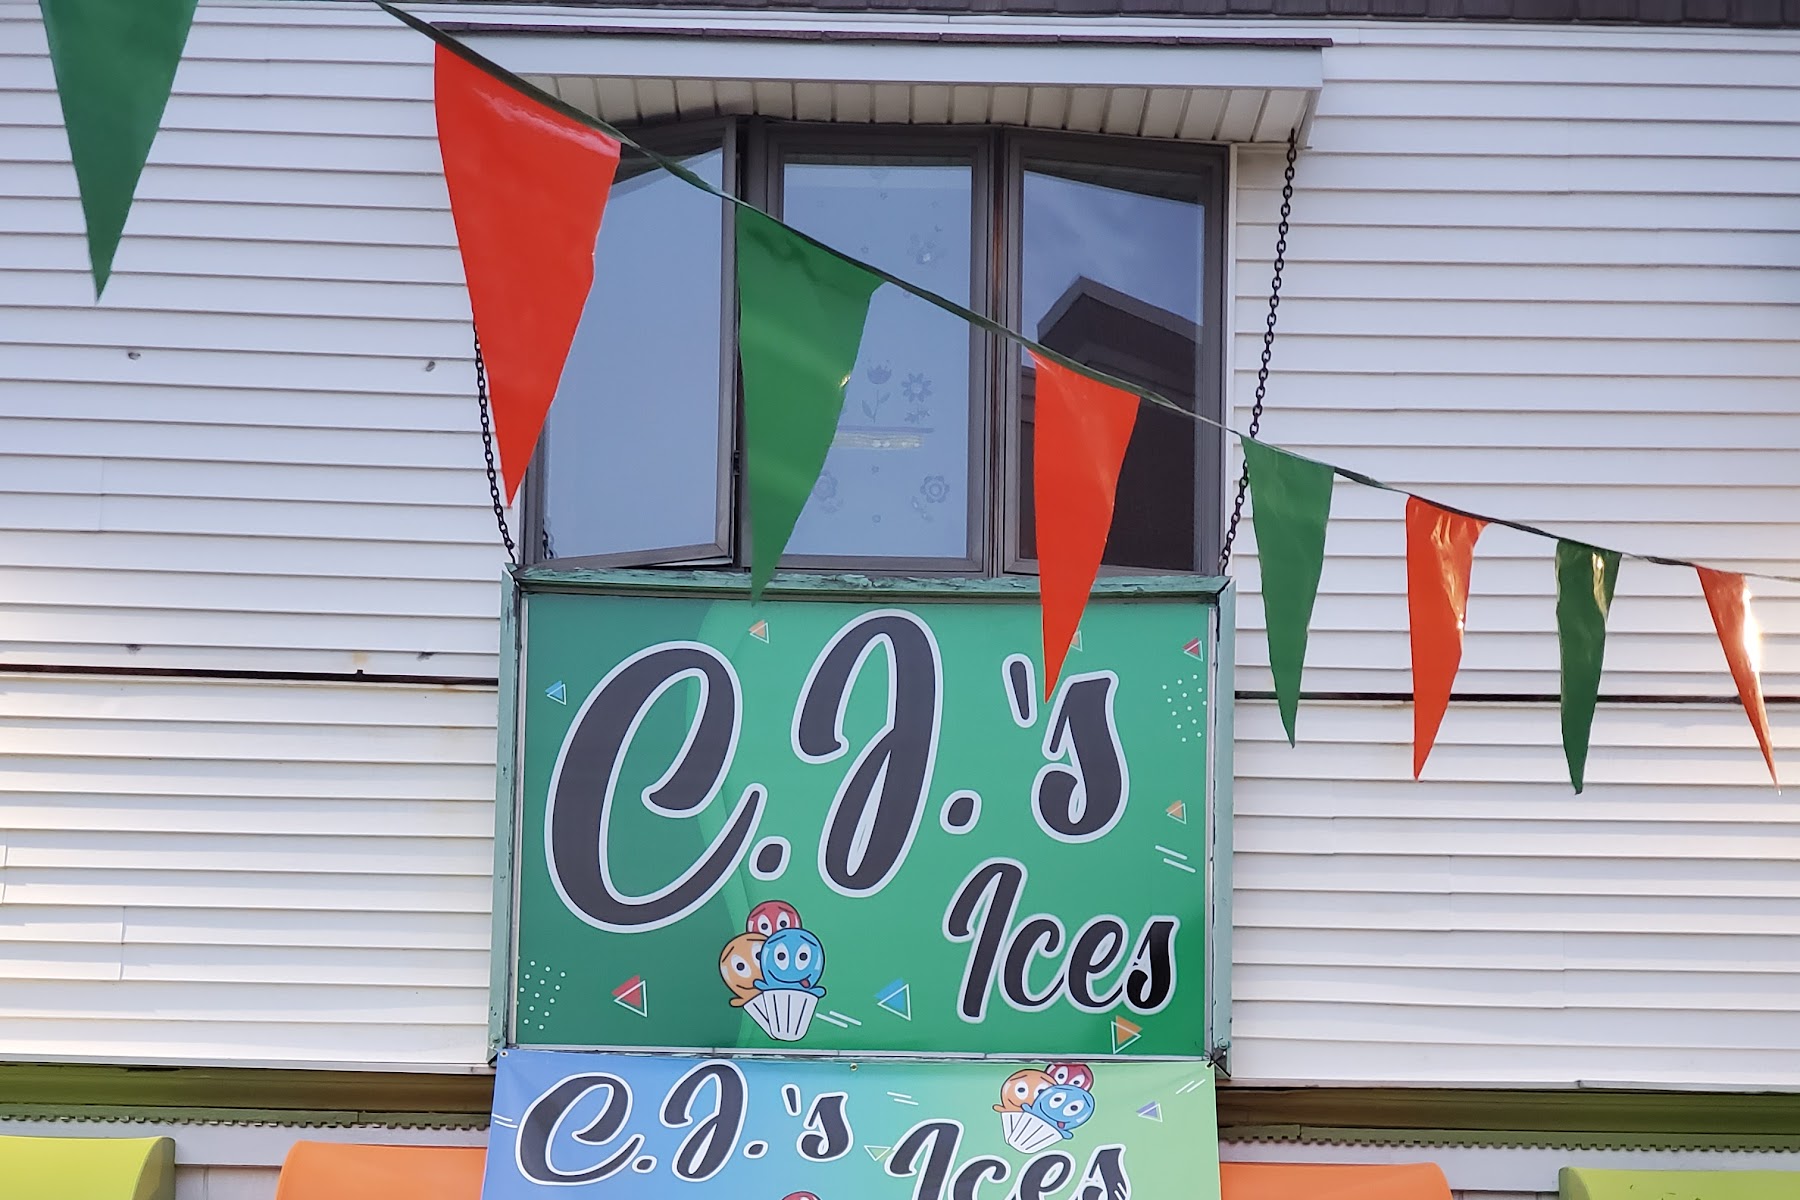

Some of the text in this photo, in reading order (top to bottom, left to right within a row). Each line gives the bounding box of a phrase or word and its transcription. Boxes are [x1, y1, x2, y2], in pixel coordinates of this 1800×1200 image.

[545, 609, 1130, 934] C.J.'s
[943, 857, 1180, 1024] Ices
[514, 1059, 853, 1187] C.J.'s
